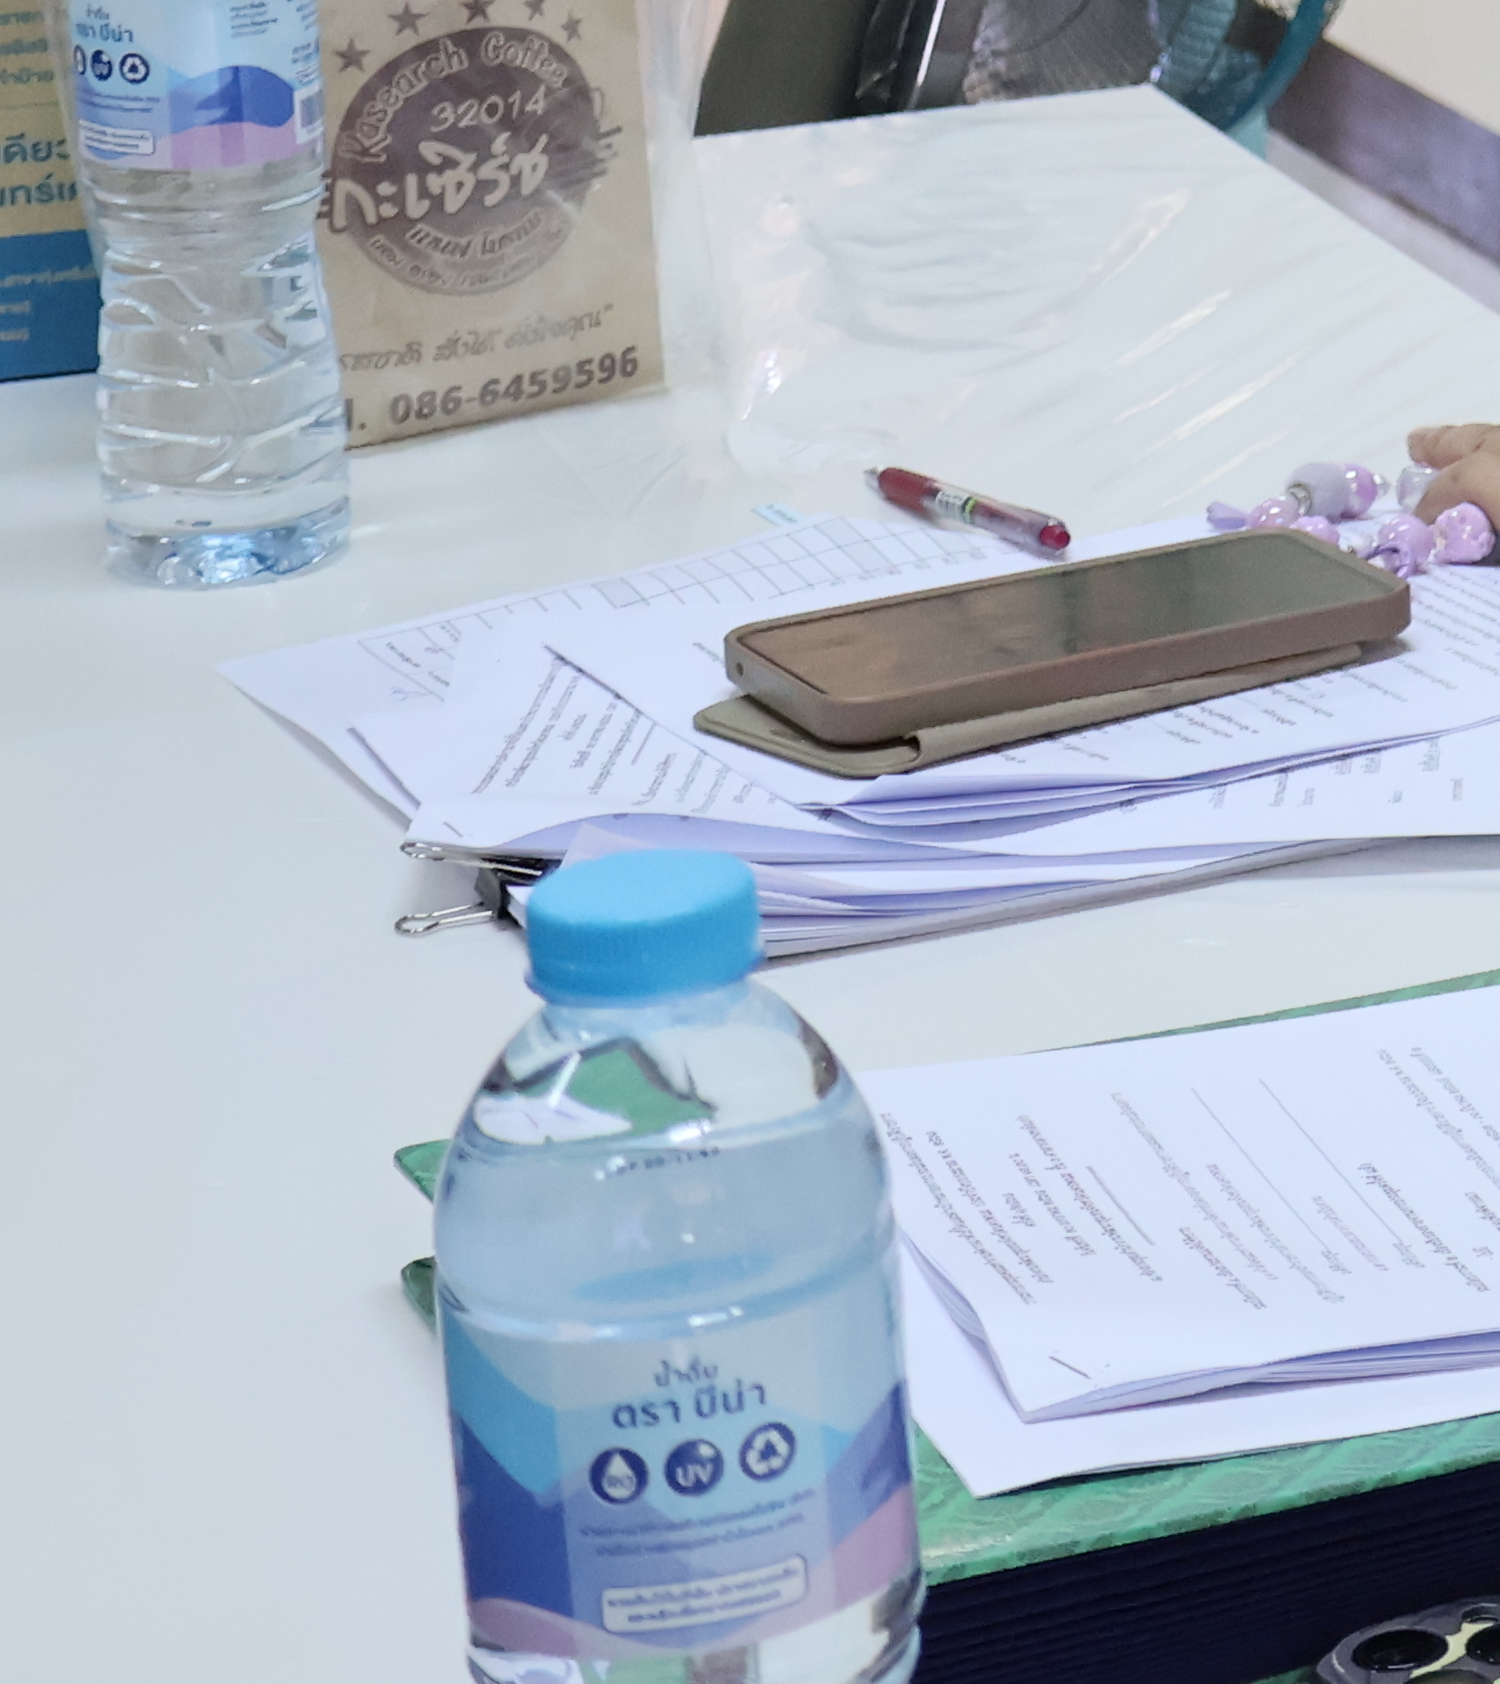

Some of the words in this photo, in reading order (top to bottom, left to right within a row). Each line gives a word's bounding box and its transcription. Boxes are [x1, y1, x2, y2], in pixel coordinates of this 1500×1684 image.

[430, 85, 547, 133] 32014
[389, 346, 639, 424] 086-6459596
[676, 1463, 714, 1489] UV
